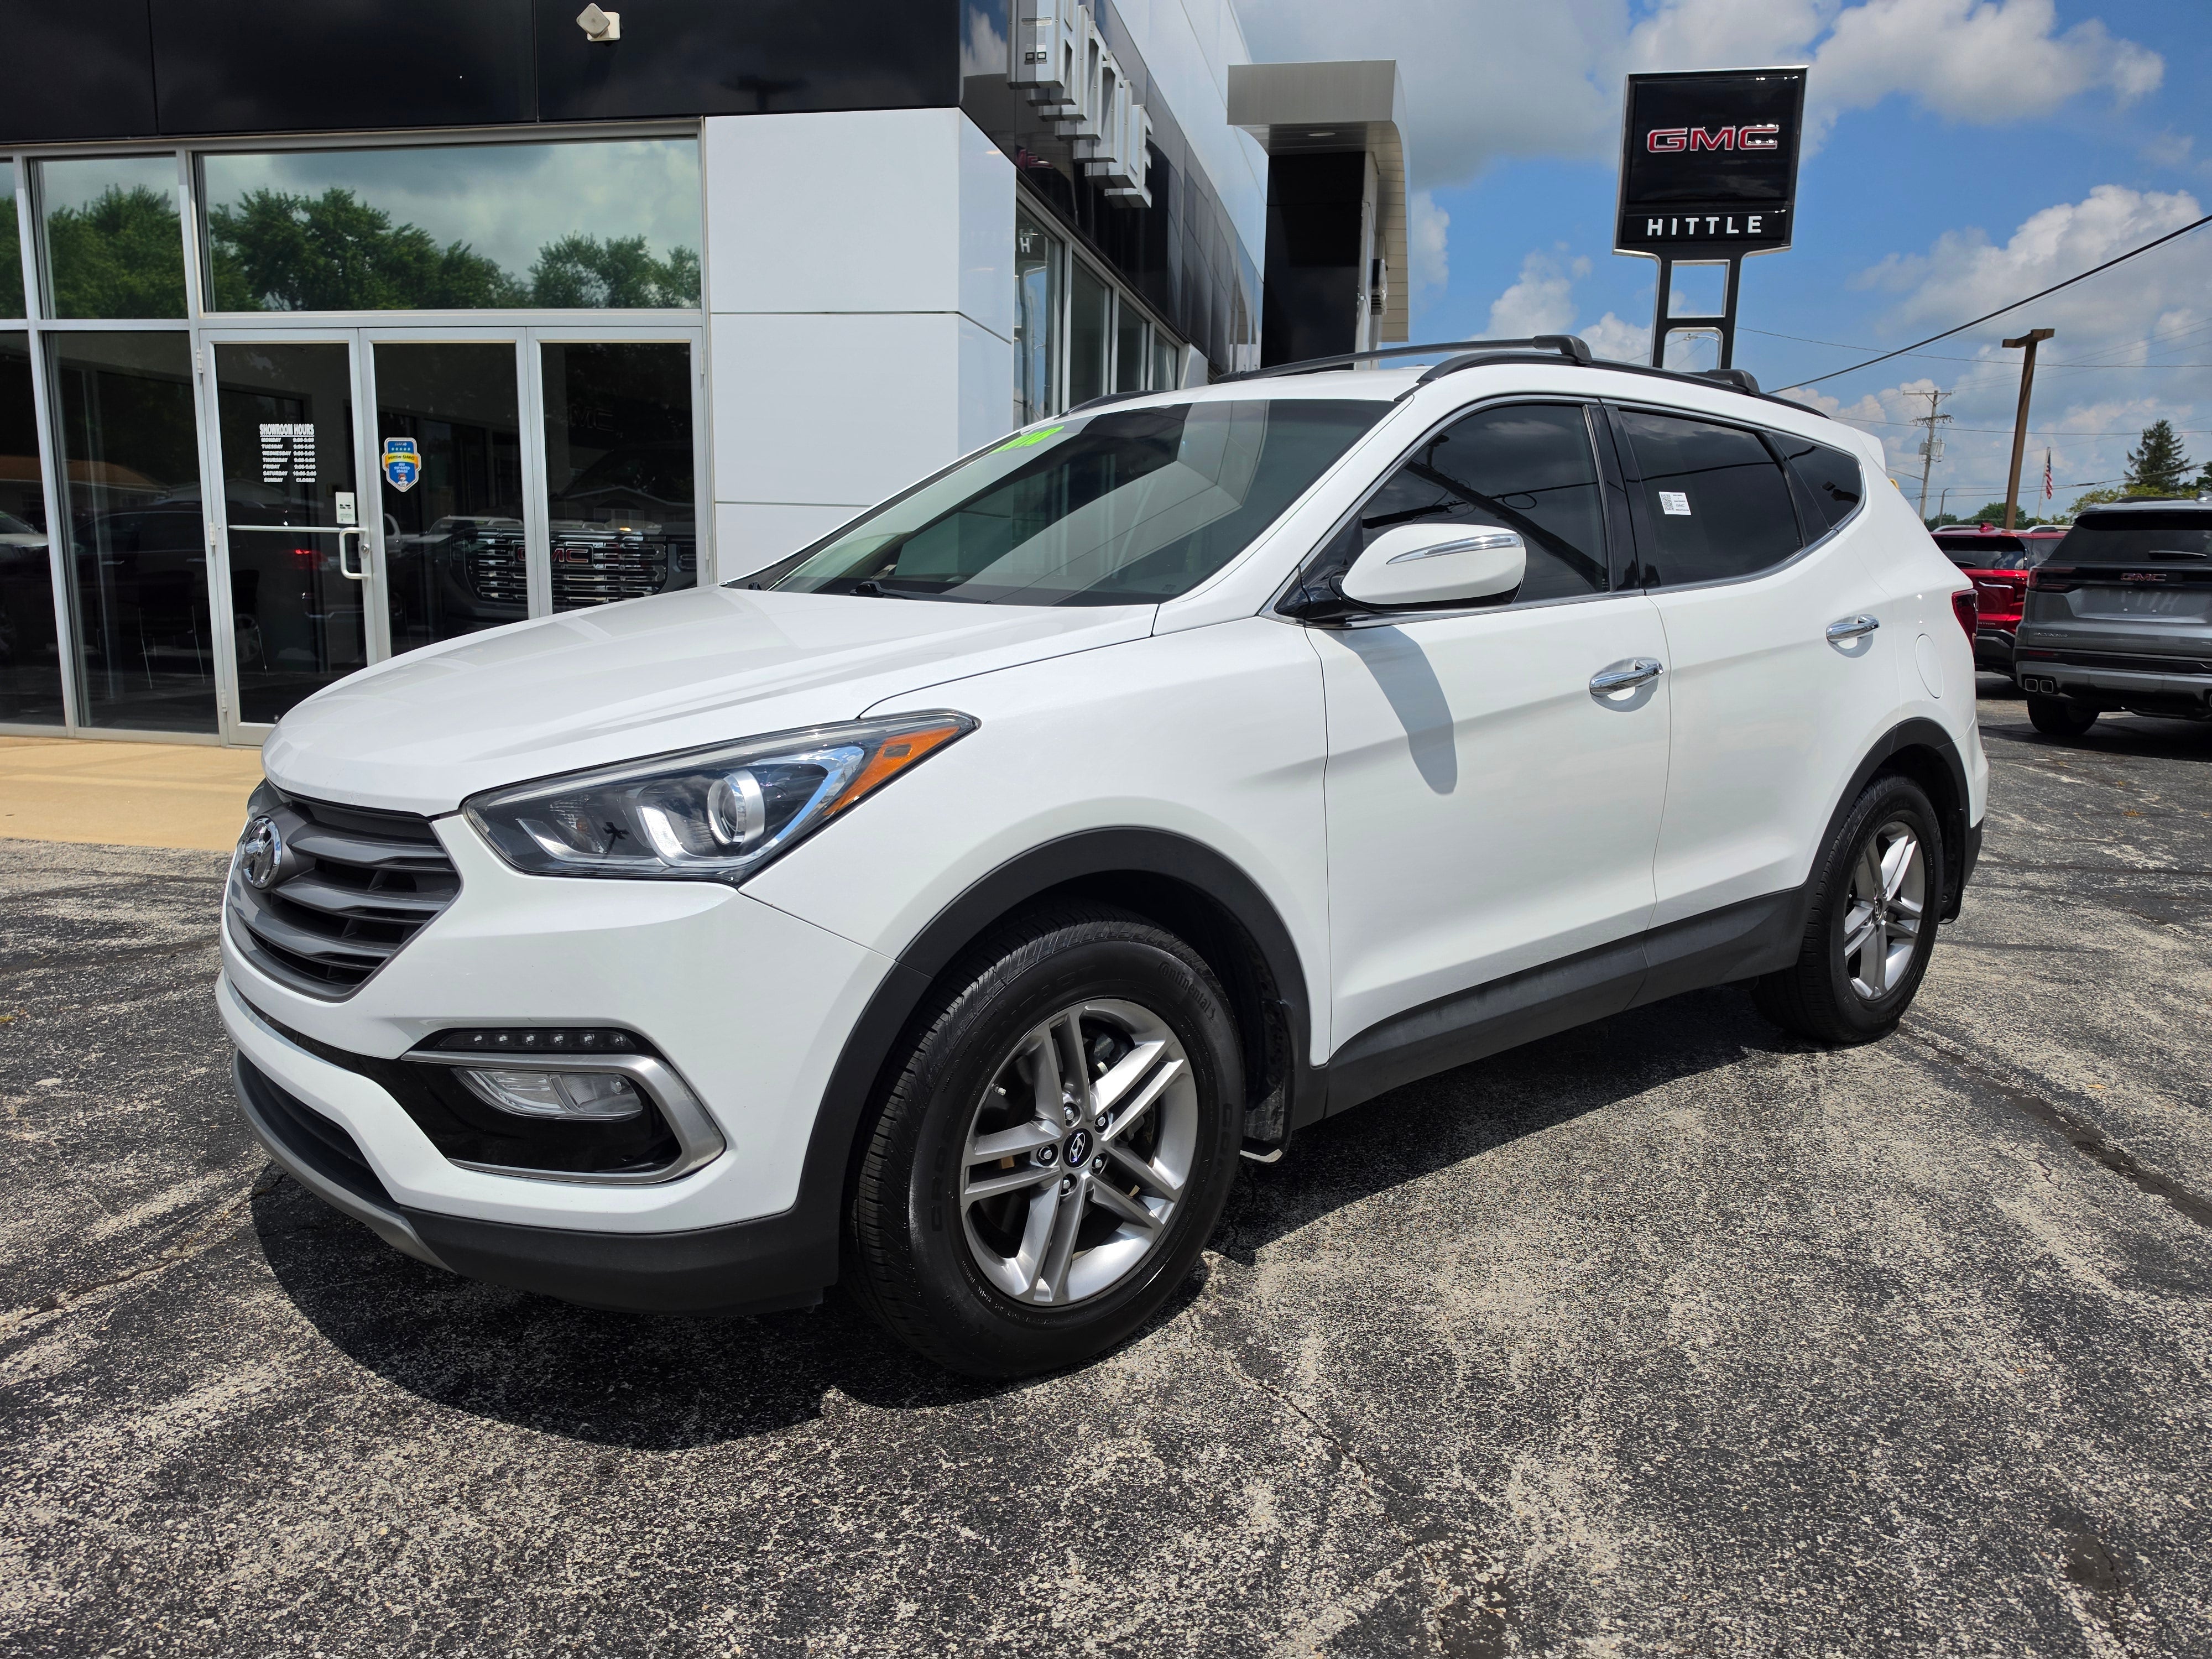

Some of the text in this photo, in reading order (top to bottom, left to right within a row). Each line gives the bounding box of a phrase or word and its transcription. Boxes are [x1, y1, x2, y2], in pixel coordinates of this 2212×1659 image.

[1647, 124, 1779, 153] GMC
[1646, 216, 1762, 236] HITTLE
[259, 424, 315, 435] SHOWROOM HOURS
[2120, 573, 2167, 581] GMC
[1158, 961, 1212, 1014] Continental
